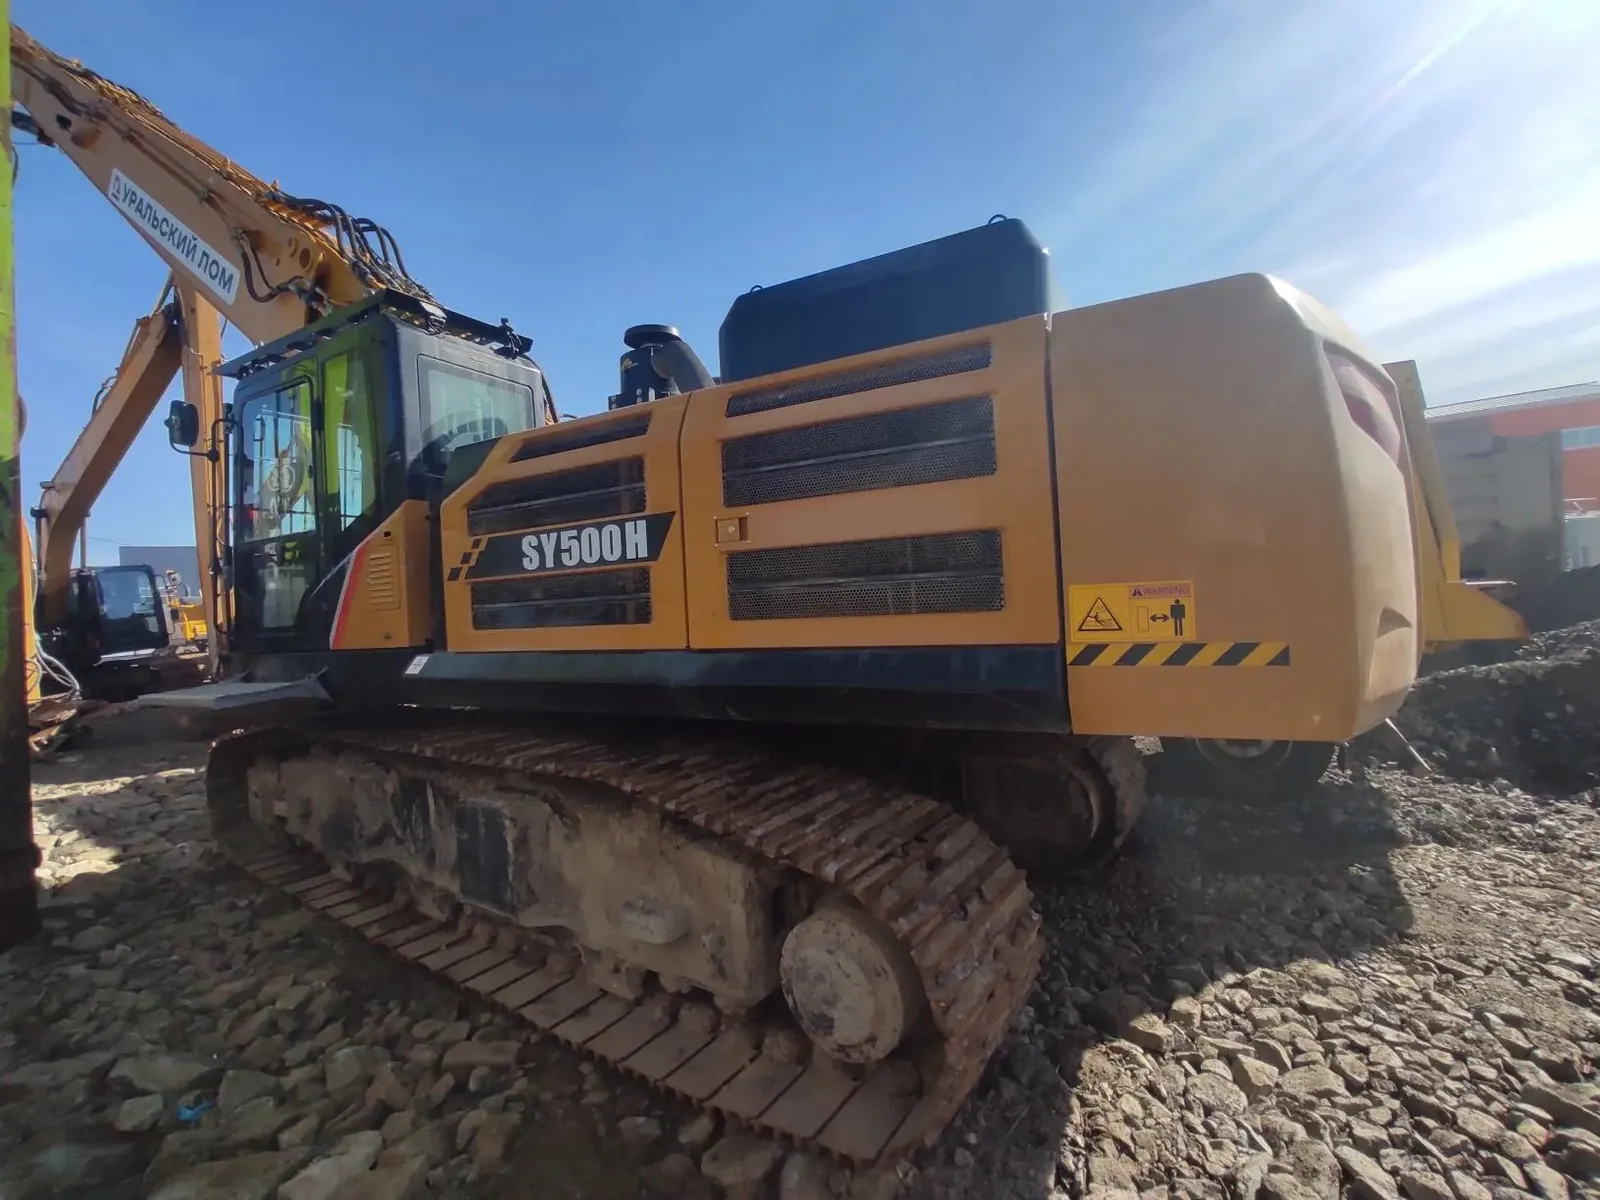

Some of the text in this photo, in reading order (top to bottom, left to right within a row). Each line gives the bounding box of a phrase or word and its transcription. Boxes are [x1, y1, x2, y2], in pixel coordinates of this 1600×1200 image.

[122, 183, 234, 294] УРАЛЬСКИЙ ЛОМ
[521, 520, 649, 571] SY500H
[1143, 585, 1189, 597] WARNING
